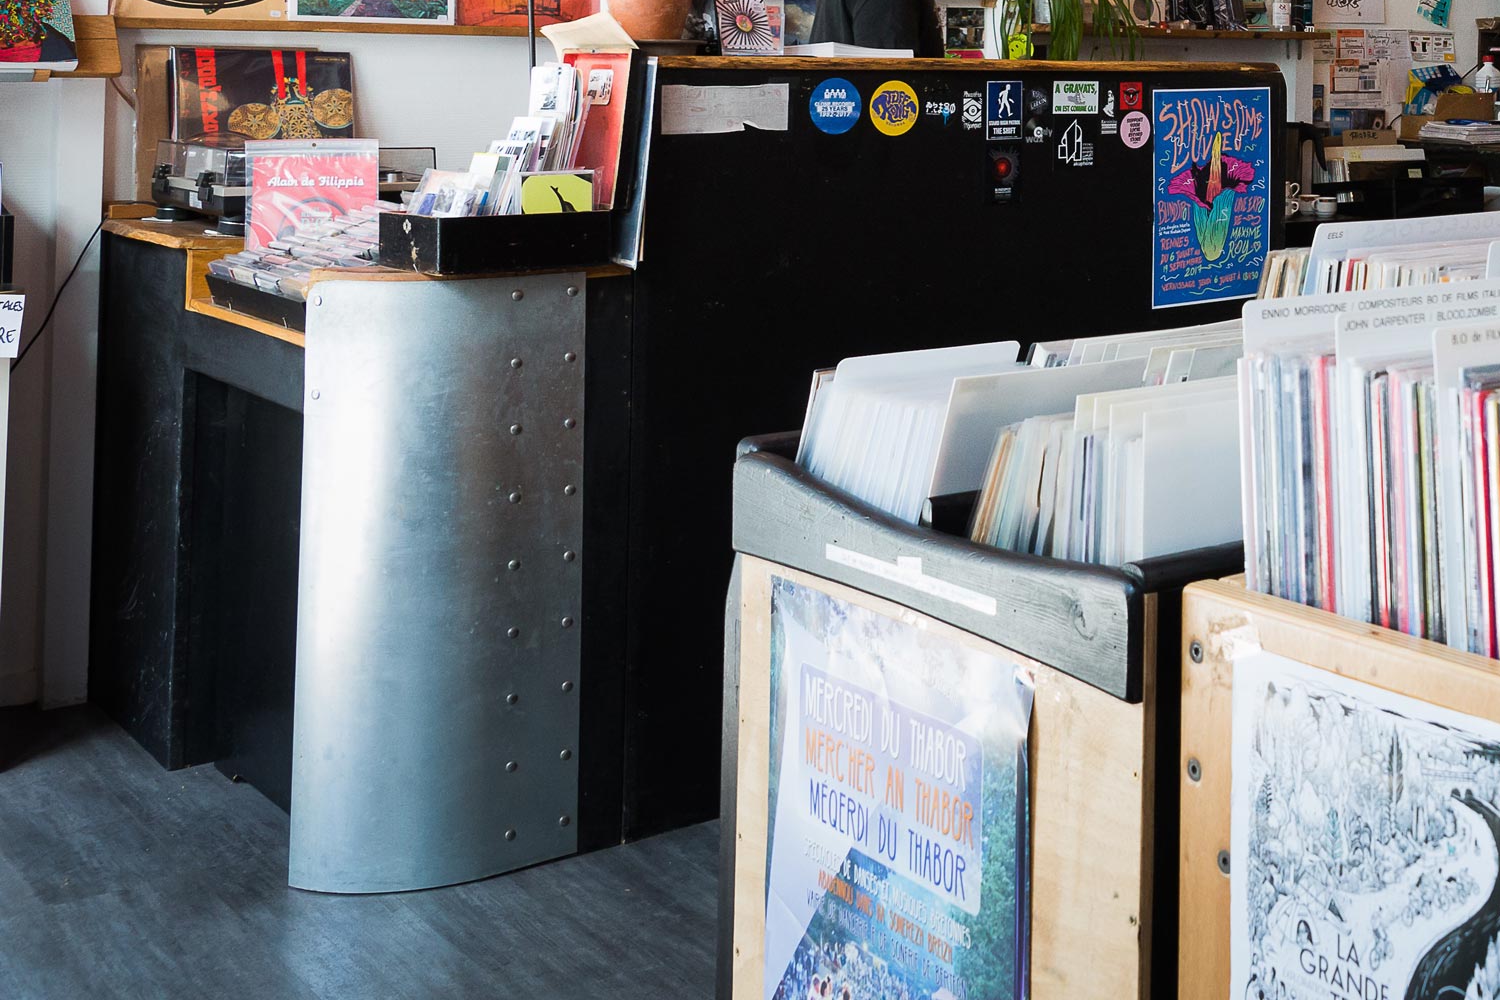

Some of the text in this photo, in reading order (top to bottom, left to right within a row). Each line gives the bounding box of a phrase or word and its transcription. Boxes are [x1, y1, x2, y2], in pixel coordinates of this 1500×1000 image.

[1055, 84, 1097, 95] A GRAVATS,
[1003, 127, 1016, 135] SHIFT
[301, 177, 315, 187] de
[319, 175, 364, 188] Filippis
[1327, 231, 1344, 240] EELS
[1170, 252, 1175, 261] 6
[1213, 276, 1218, 284] 6
[1262, 307, 1289, 320] ENNIO
[1294, 303, 1347, 317] MORRICONE
[1358, 296, 1423, 311] COMPOSITEURS
[1427, 295, 1438, 305] BO
[1442, 293, 1453, 303] DE
[1457, 291, 1478, 301] FILMS
[1345, 320, 1369, 332] JOHN
[1373, 314, 1425, 328] CARPENTER
[1473, 334, 1481, 342] de
[804, 674, 967, 792] MERCREDI DU THABOR
[805, 727, 973, 850] MERC'HER AN THABOR
[809, 778, 966, 901] MÉQERDI DU THABOR
[1337, 934, 1360, 968] LA
[1300, 948, 1389, 1000] GRANDE
